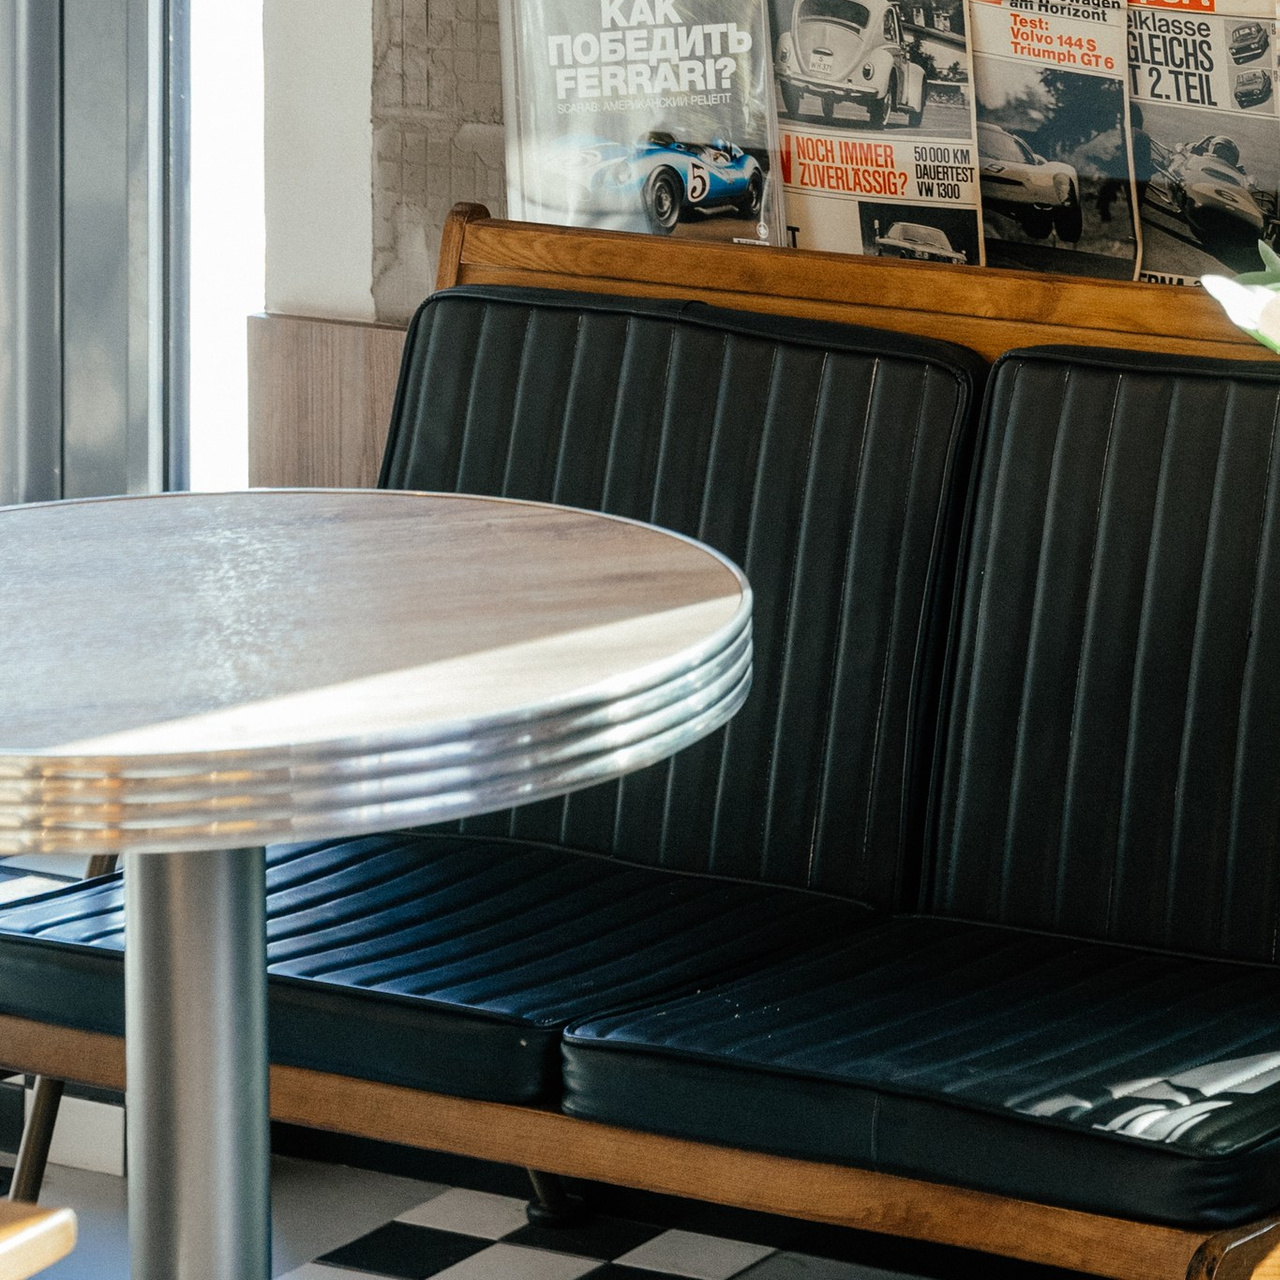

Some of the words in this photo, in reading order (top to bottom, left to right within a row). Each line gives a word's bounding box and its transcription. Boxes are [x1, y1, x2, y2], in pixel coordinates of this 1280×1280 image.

[1010, 13, 1049, 31] Test:
[548, 22, 753, 67] ПОБЕДИТЬ
[1010, 27, 1053, 46] Volvo
[1010, 41, 1076, 65] Triumph
[555, 56, 737, 100] FERRARI?
[690, 92, 732, 107] РЕЦЕПТ
[795, 135, 835, 163] NOCH
[838, 141, 895, 169] IMMER
[952, 148, 970, 165] KM
[690, 162, 707, 200] 5
[799, 162, 908, 196] ZUVERLÄSSIG?
[915, 164, 975, 183] DAUERTEST
[917, 182, 934, 197] VW
[936, 182, 960, 199] 1300
